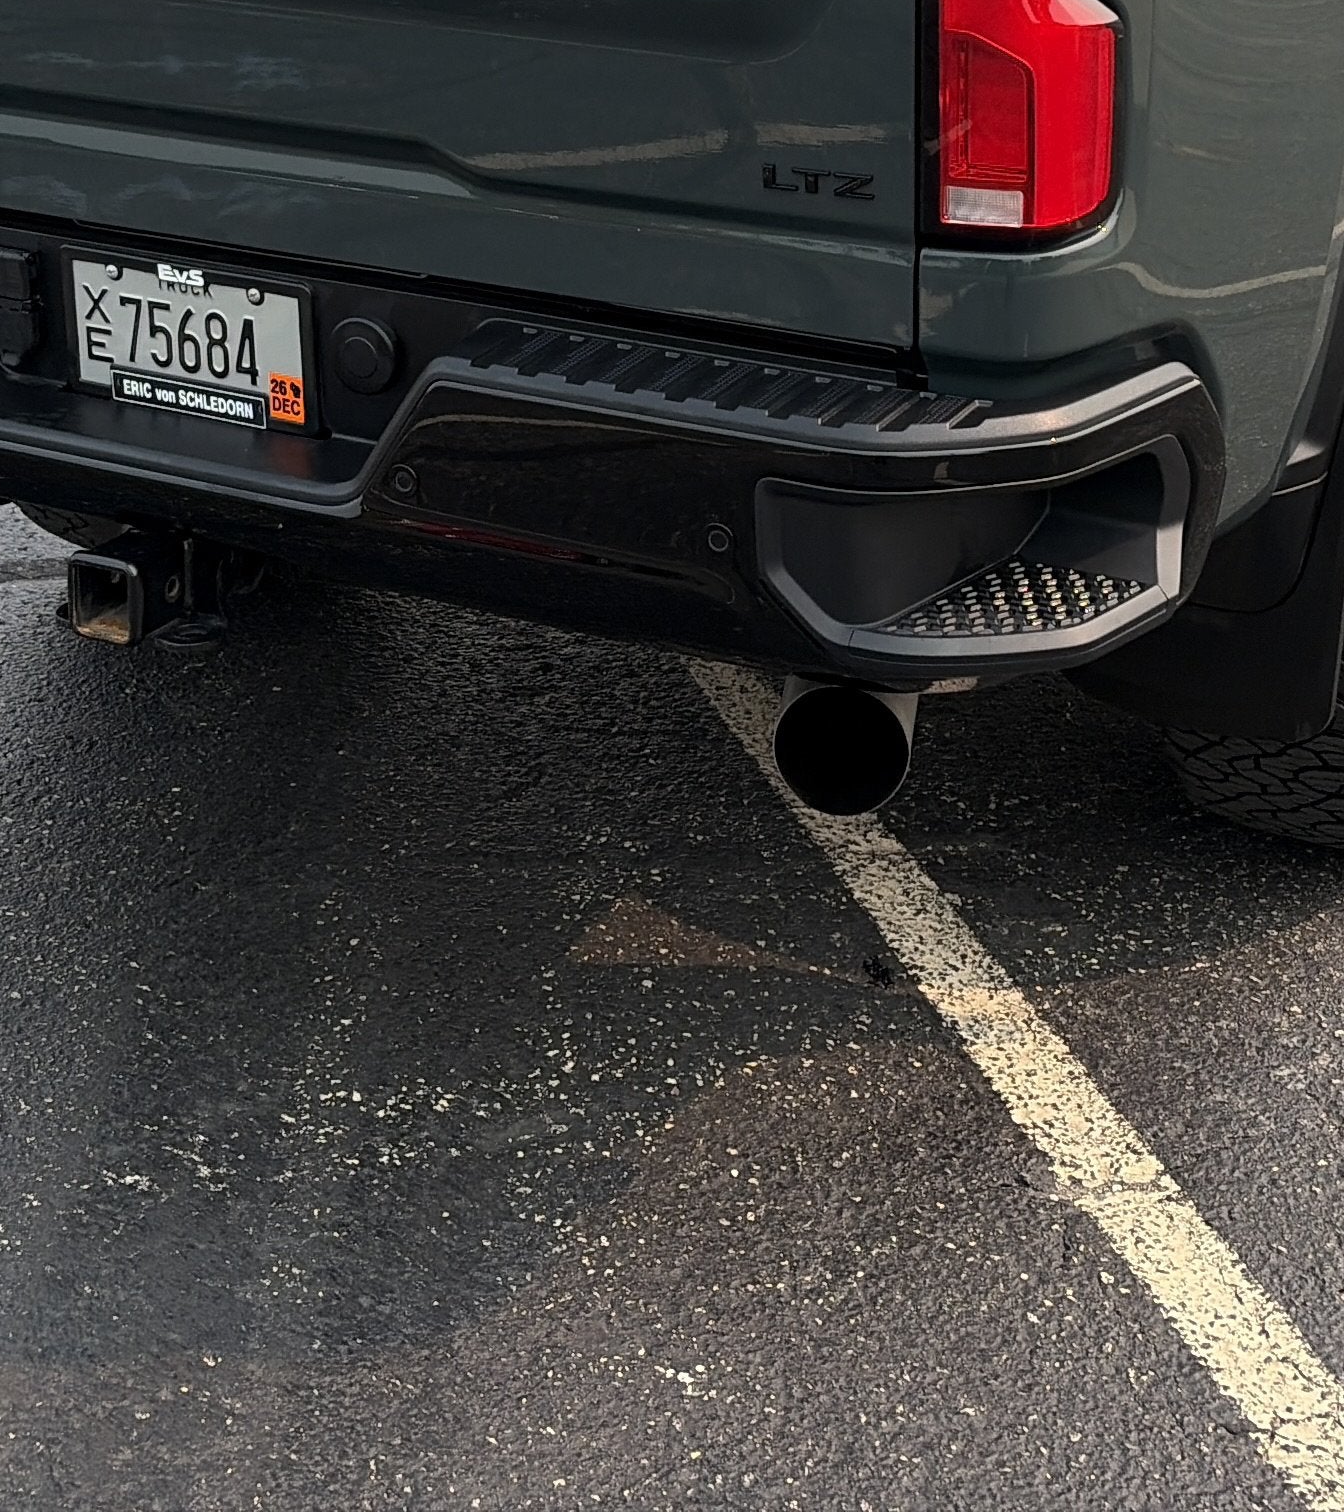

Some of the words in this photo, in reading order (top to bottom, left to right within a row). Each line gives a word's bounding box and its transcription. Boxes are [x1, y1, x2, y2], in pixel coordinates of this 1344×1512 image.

[762, 163, 876, 200] LTZ
[119, 296, 259, 386] 75684
[122, 379, 152, 399] ERIC
[155, 388, 176, 404] von
[178, 389, 254, 419] SCHLEDORN
[271, 378, 287, 396] 26
[272, 395, 301, 416] DEC
